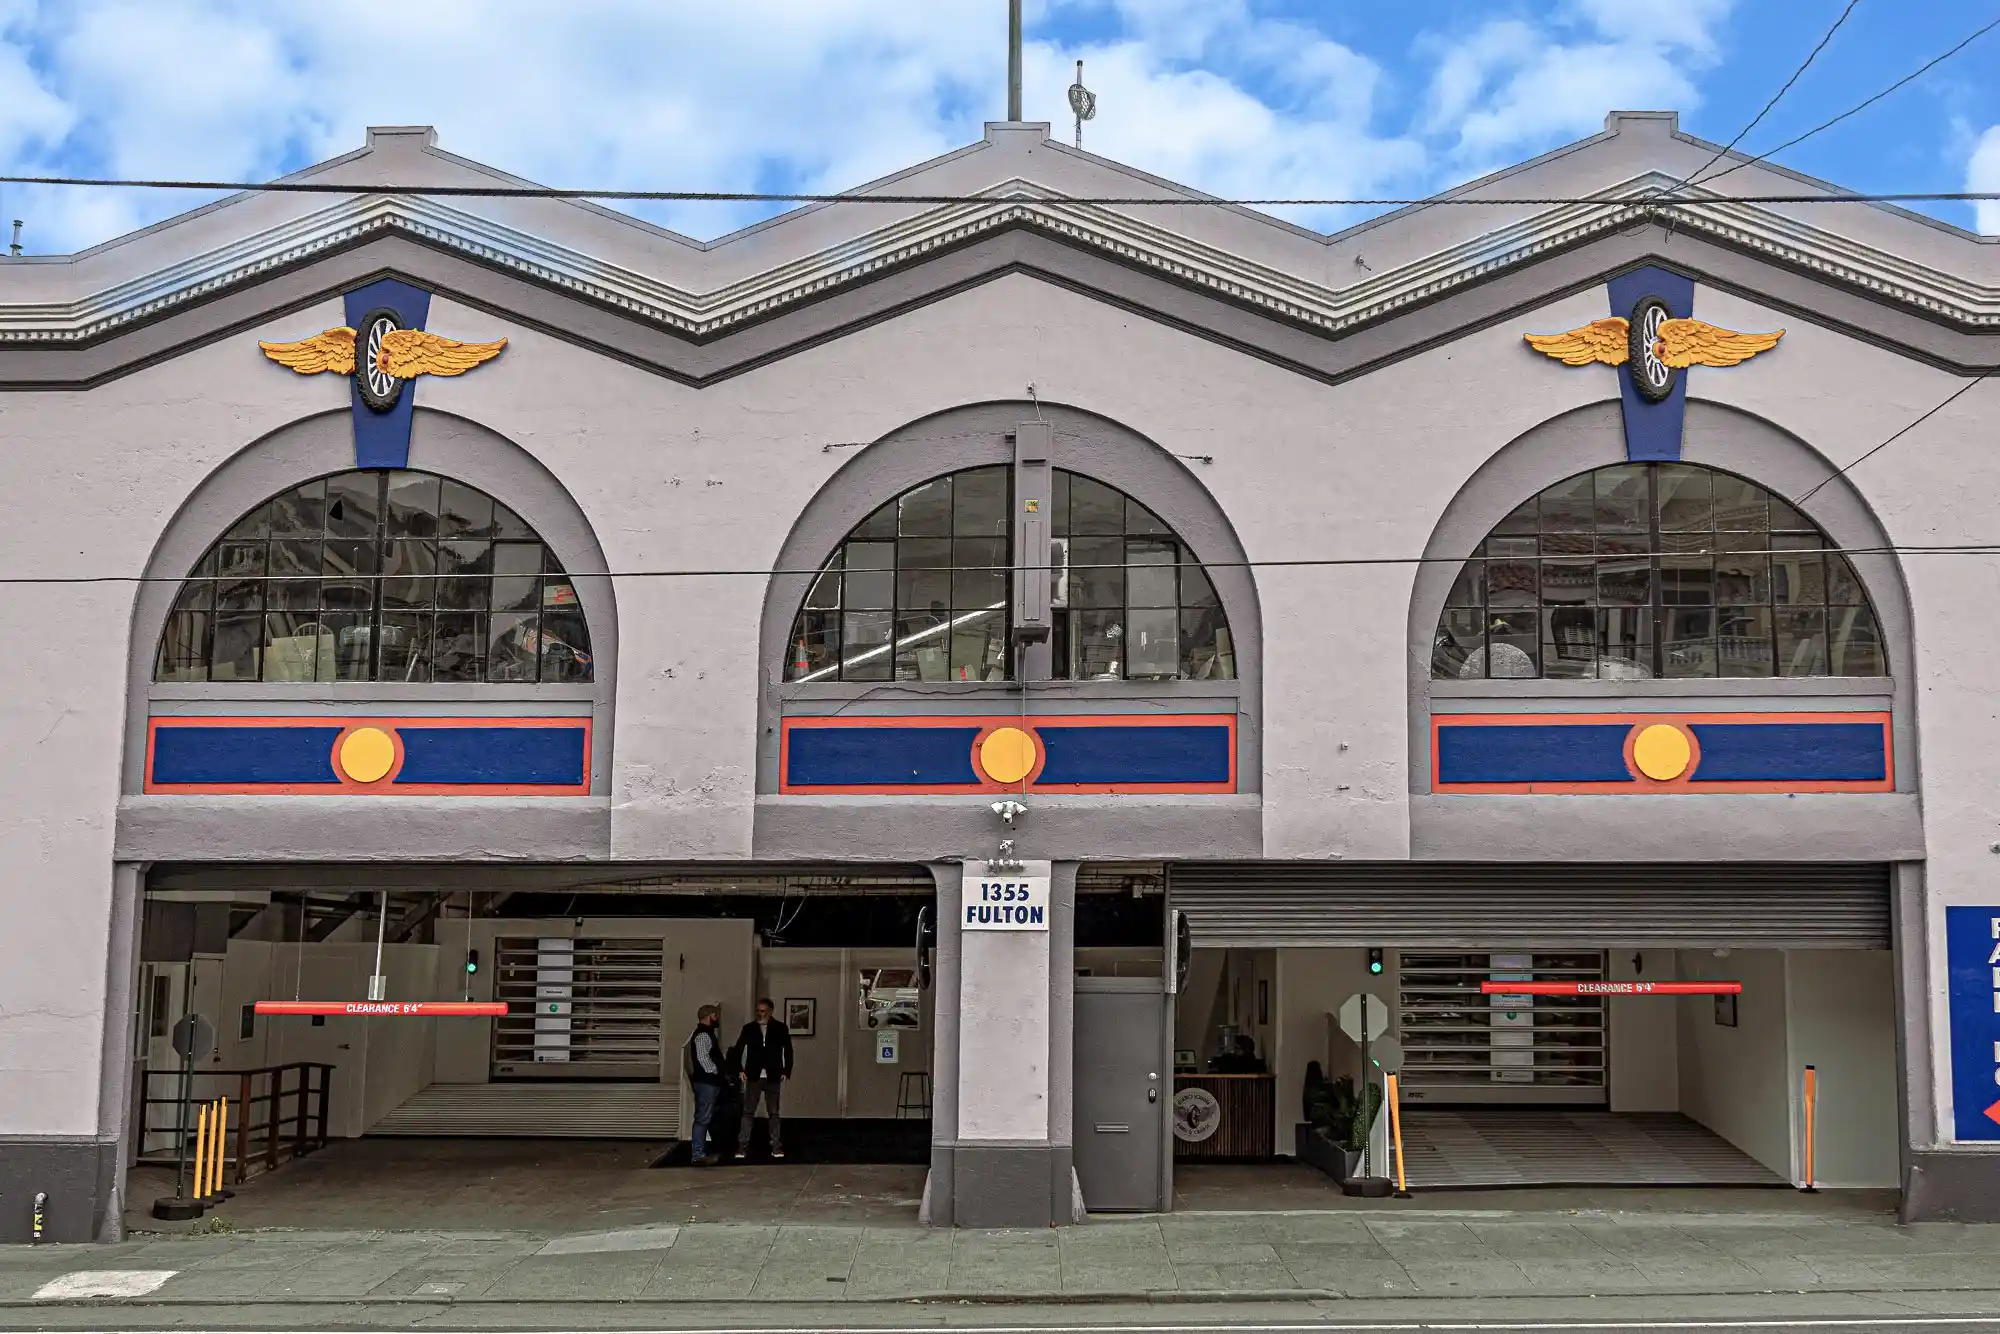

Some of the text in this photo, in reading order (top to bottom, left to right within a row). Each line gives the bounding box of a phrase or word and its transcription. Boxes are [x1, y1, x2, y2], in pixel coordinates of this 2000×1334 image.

[981, 883, 1030, 902] 1355
[966, 905, 1044, 924] FULTON
[1577, 983, 1633, 993] CLEARANCE
[346, 1003, 423, 1013] CLEARANCE 6'4"
